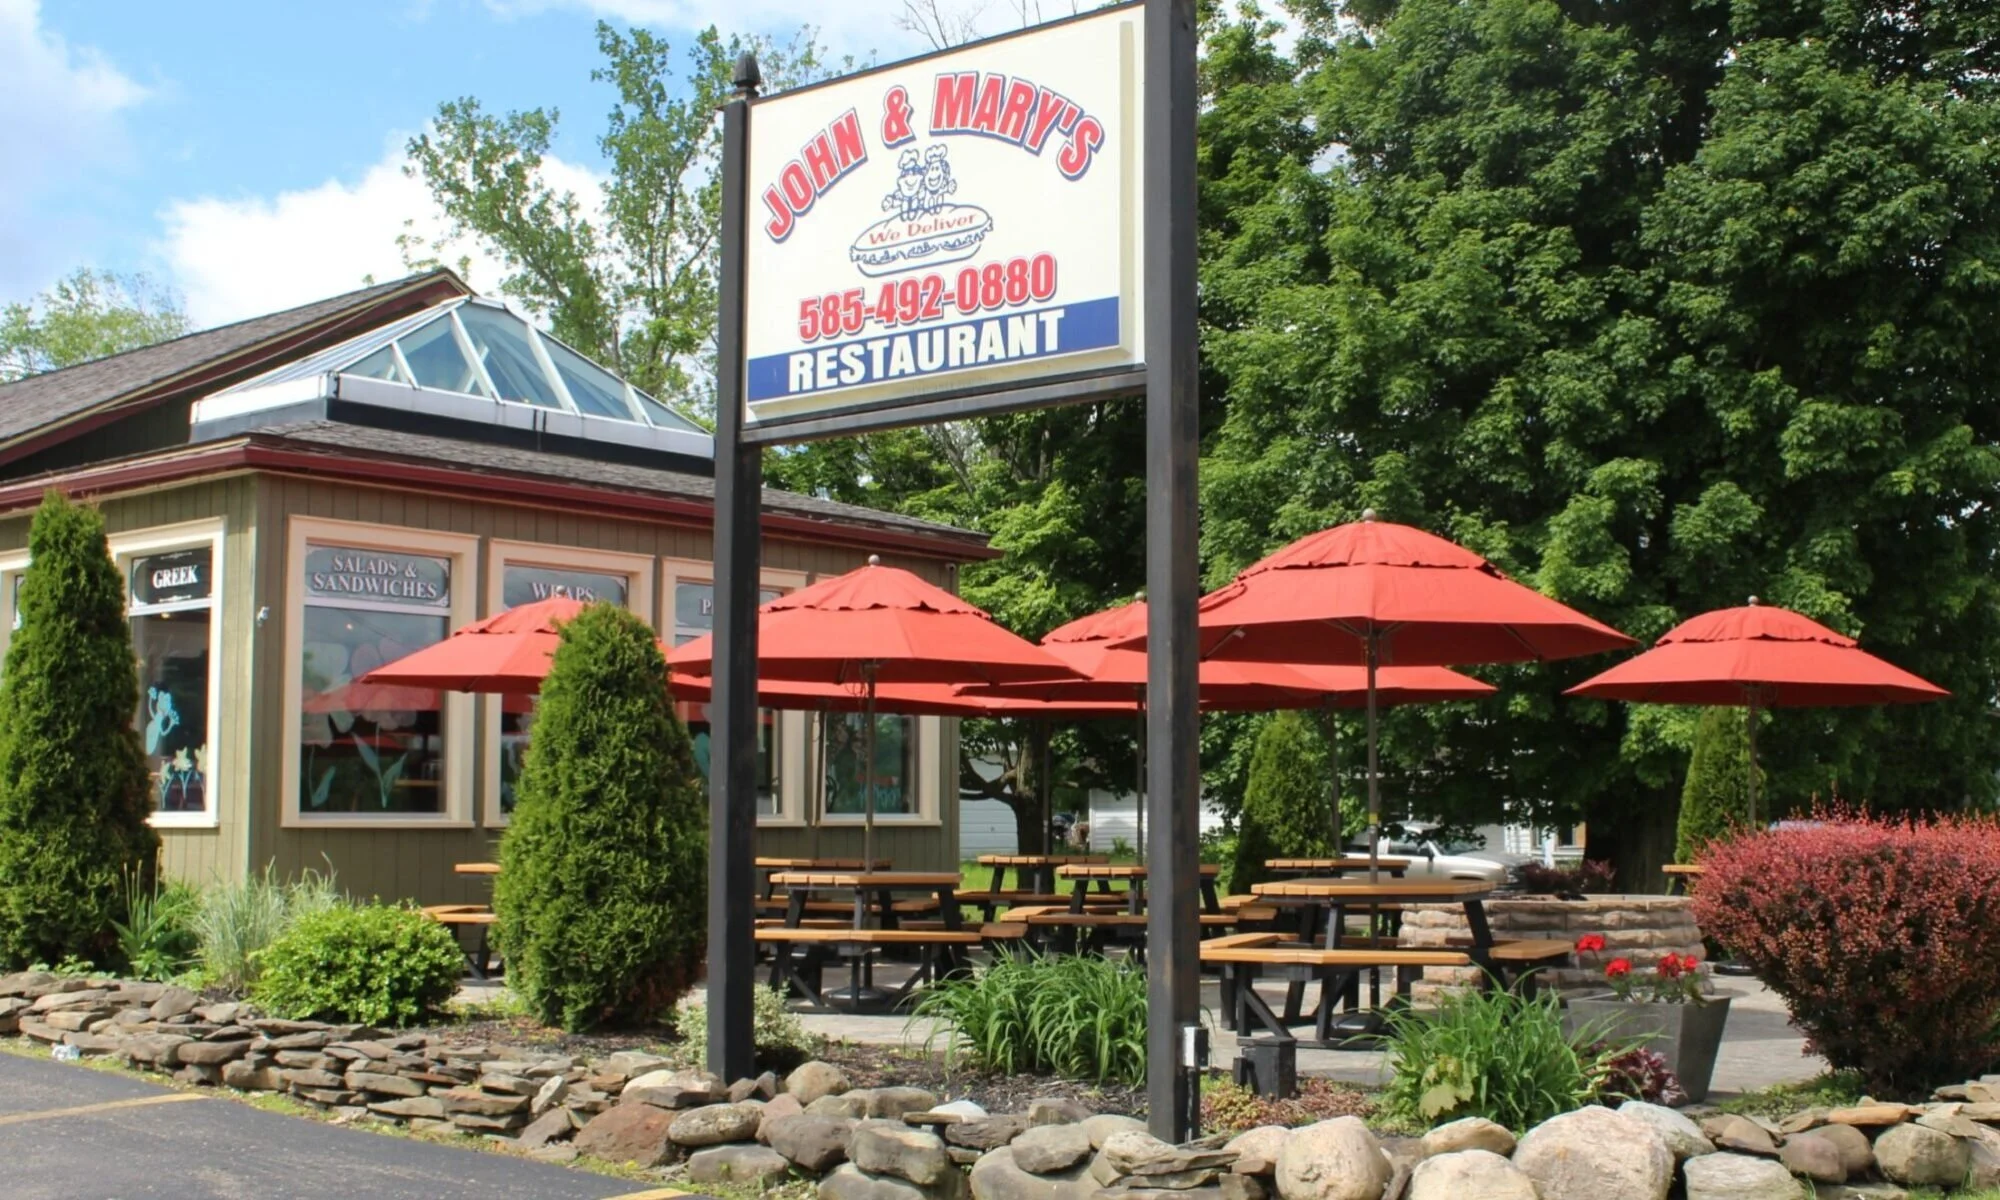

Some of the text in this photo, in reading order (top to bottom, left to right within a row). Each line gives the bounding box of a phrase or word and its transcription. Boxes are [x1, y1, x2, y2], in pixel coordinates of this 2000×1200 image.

[762, 71, 1104, 243] JOHN & MARY'S
[869, 214, 976, 244] We Deliver
[798, 253, 1057, 343] 585-492-0880
[788, 310, 1064, 393] RESTAURANT
[152, 565, 198, 589] GREEK
[333, 555, 417, 578] SALADS &
[313, 572, 437, 598] SANDWICHES
